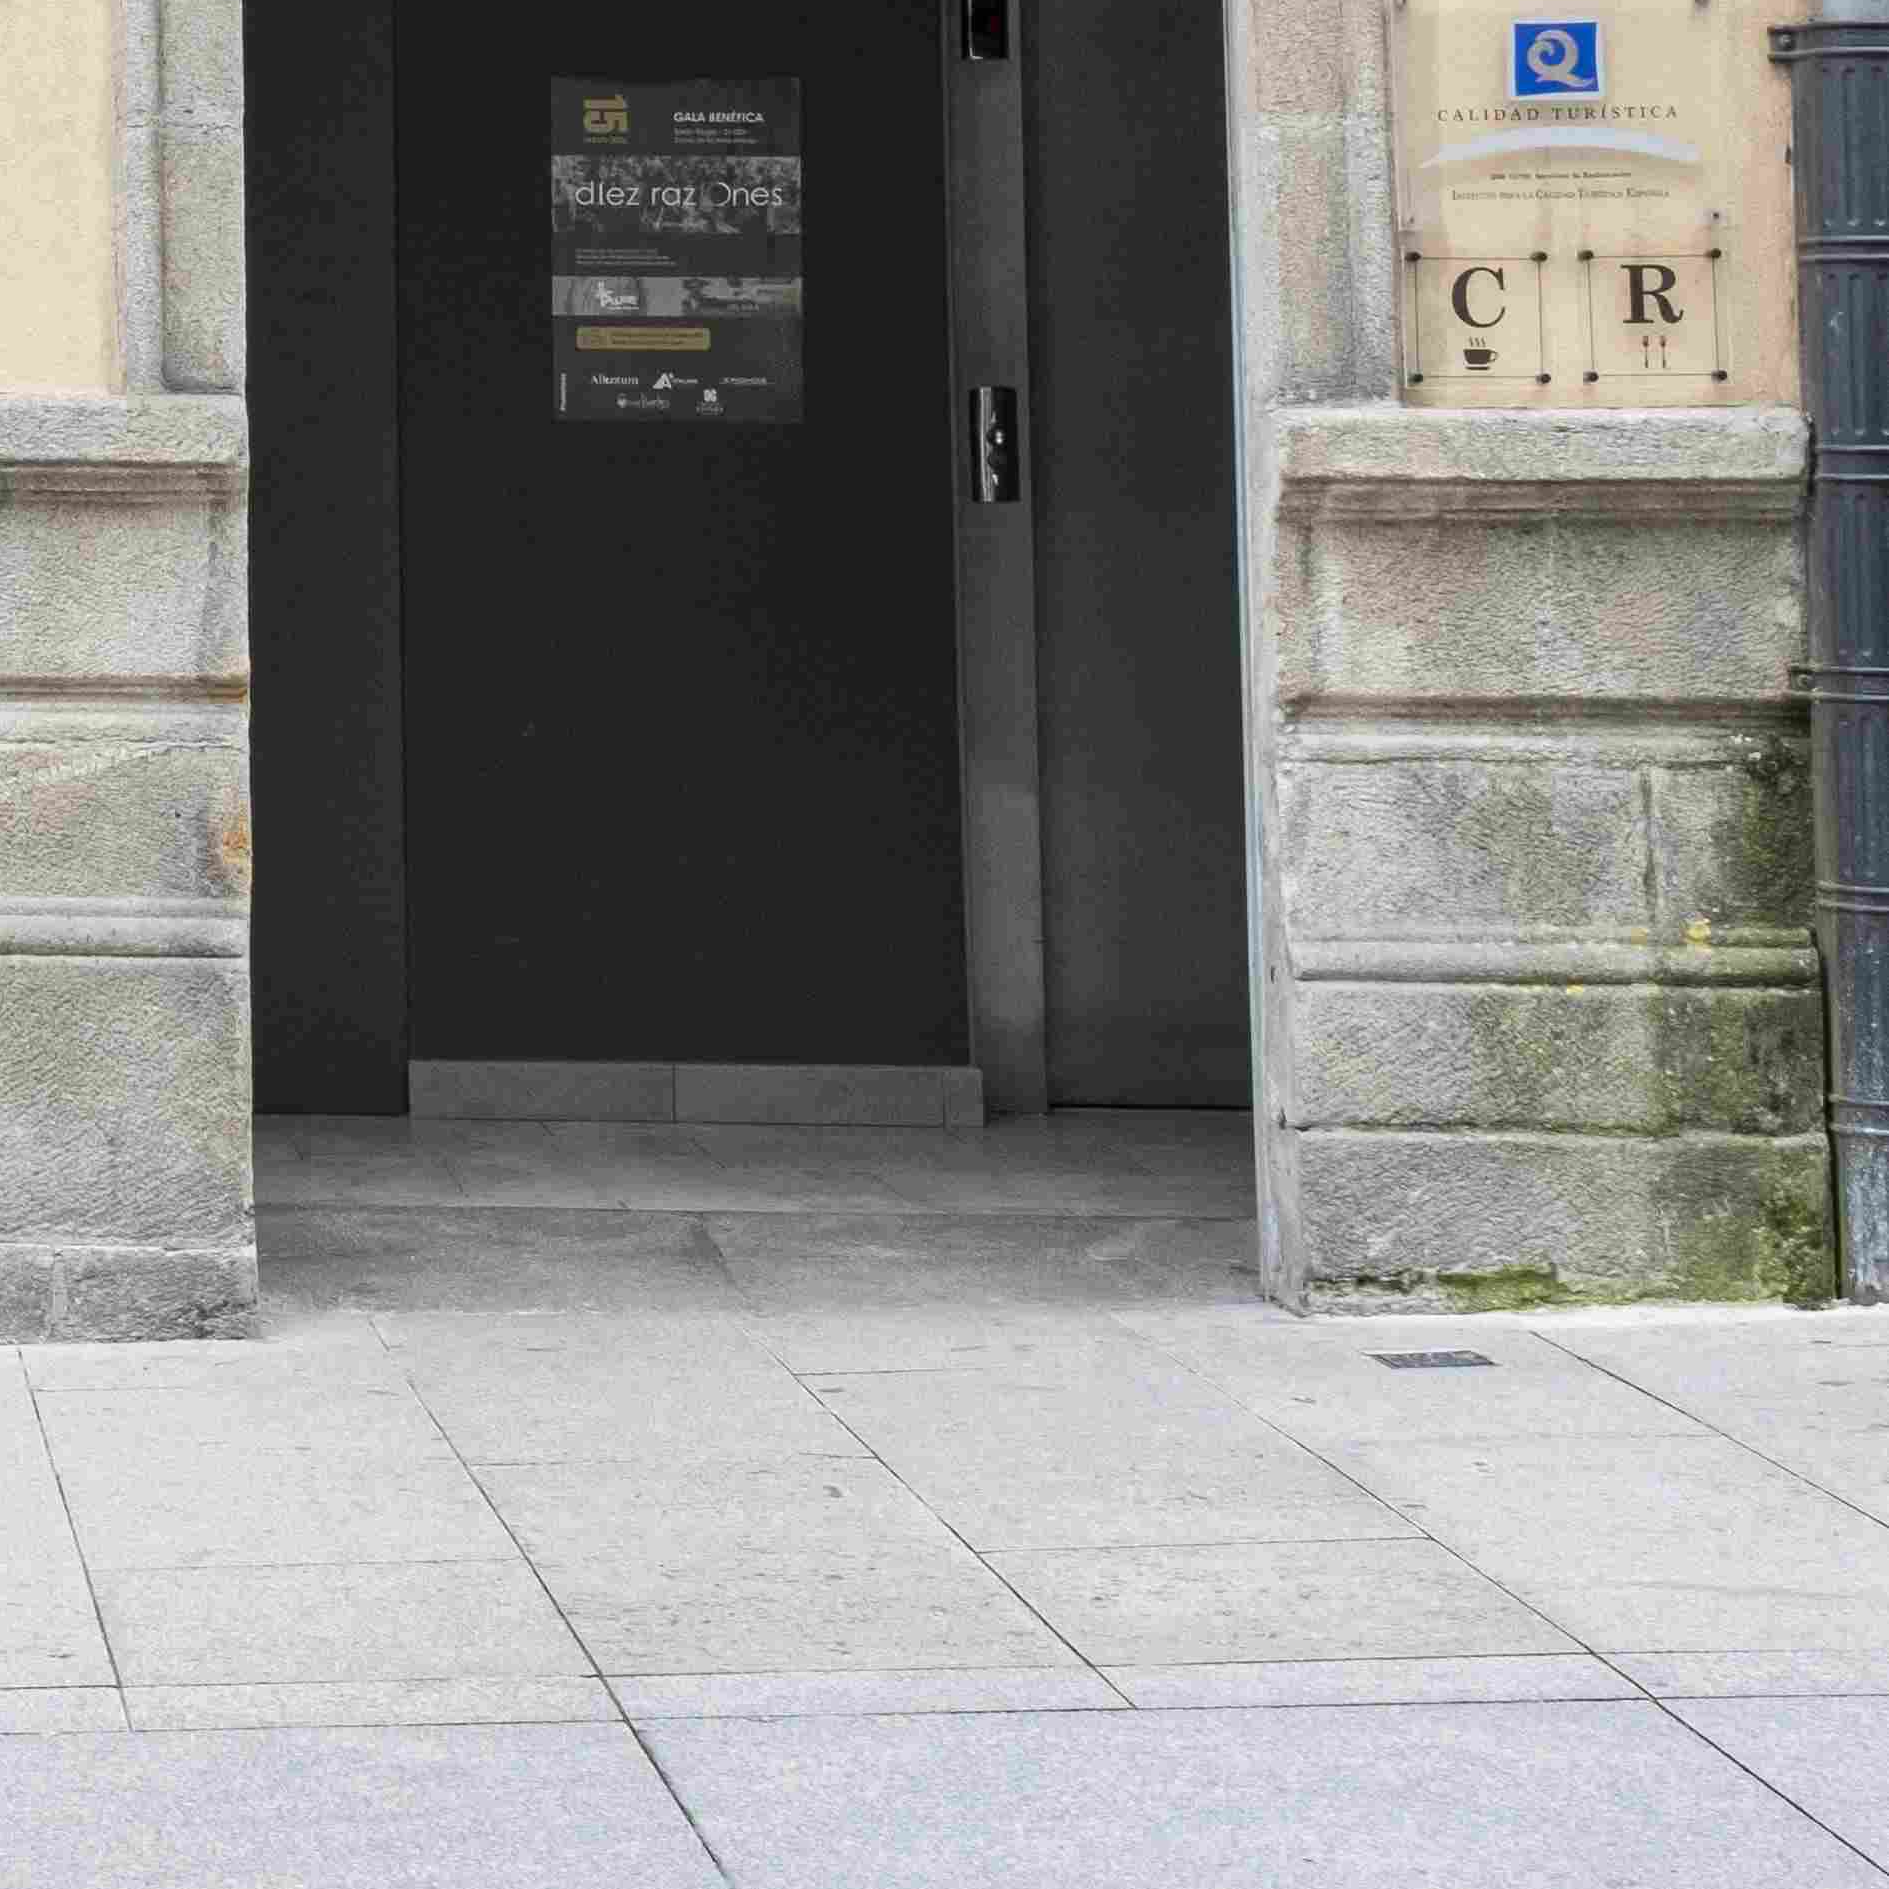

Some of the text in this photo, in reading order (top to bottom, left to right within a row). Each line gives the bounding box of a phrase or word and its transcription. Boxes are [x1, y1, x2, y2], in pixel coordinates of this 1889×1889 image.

[673, 111, 706, 123] GALA
[1437, 102, 1679, 123] CALIDAD TURÍSTICA
[1450, 263, 1685, 329] C R
